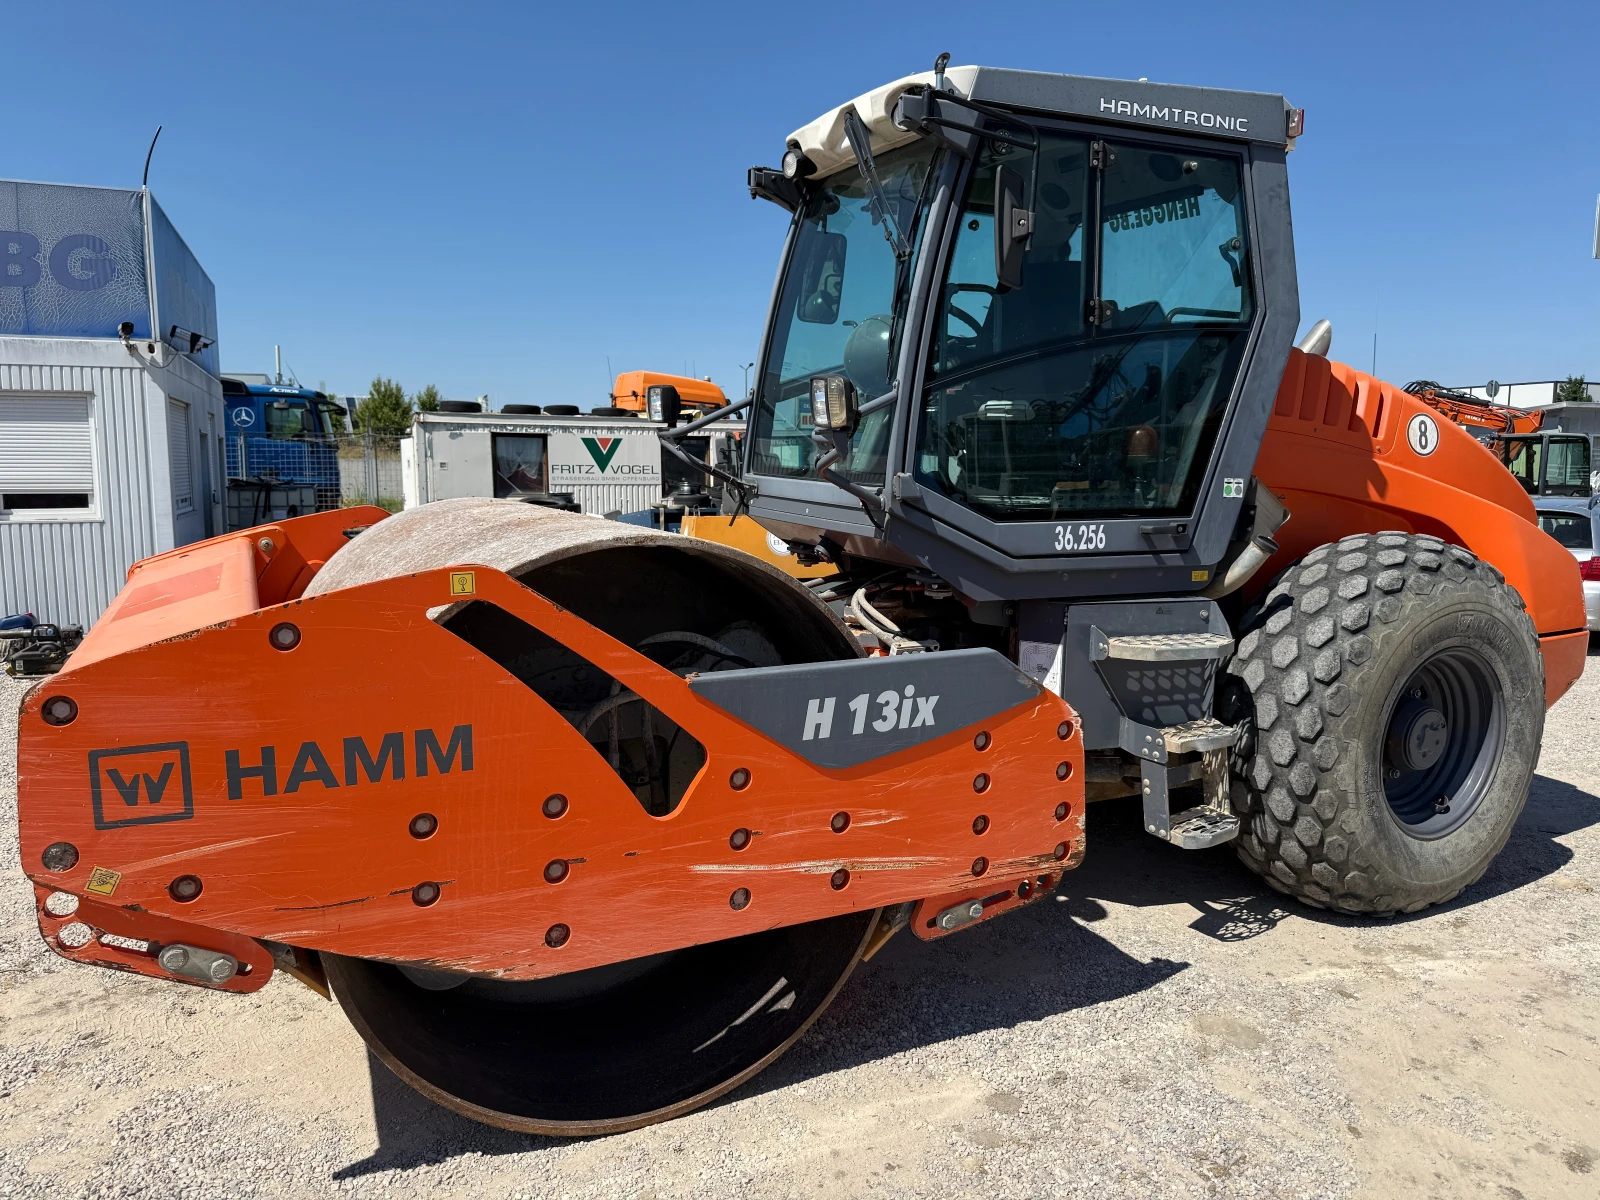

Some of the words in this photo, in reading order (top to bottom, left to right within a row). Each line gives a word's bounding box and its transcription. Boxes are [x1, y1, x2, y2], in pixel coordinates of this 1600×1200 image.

[1100, 97, 1249, 132] HAMMTRONIC
[1418, 419, 1428, 450] 8
[551, 464, 595, 475] FRITZ
[610, 464, 659, 475] VOGEL
[1054, 524, 1106, 551] 36.256
[802, 697, 836, 741] H
[848, 684, 940, 736] 13ix
[225, 724, 474, 800] HAMM
